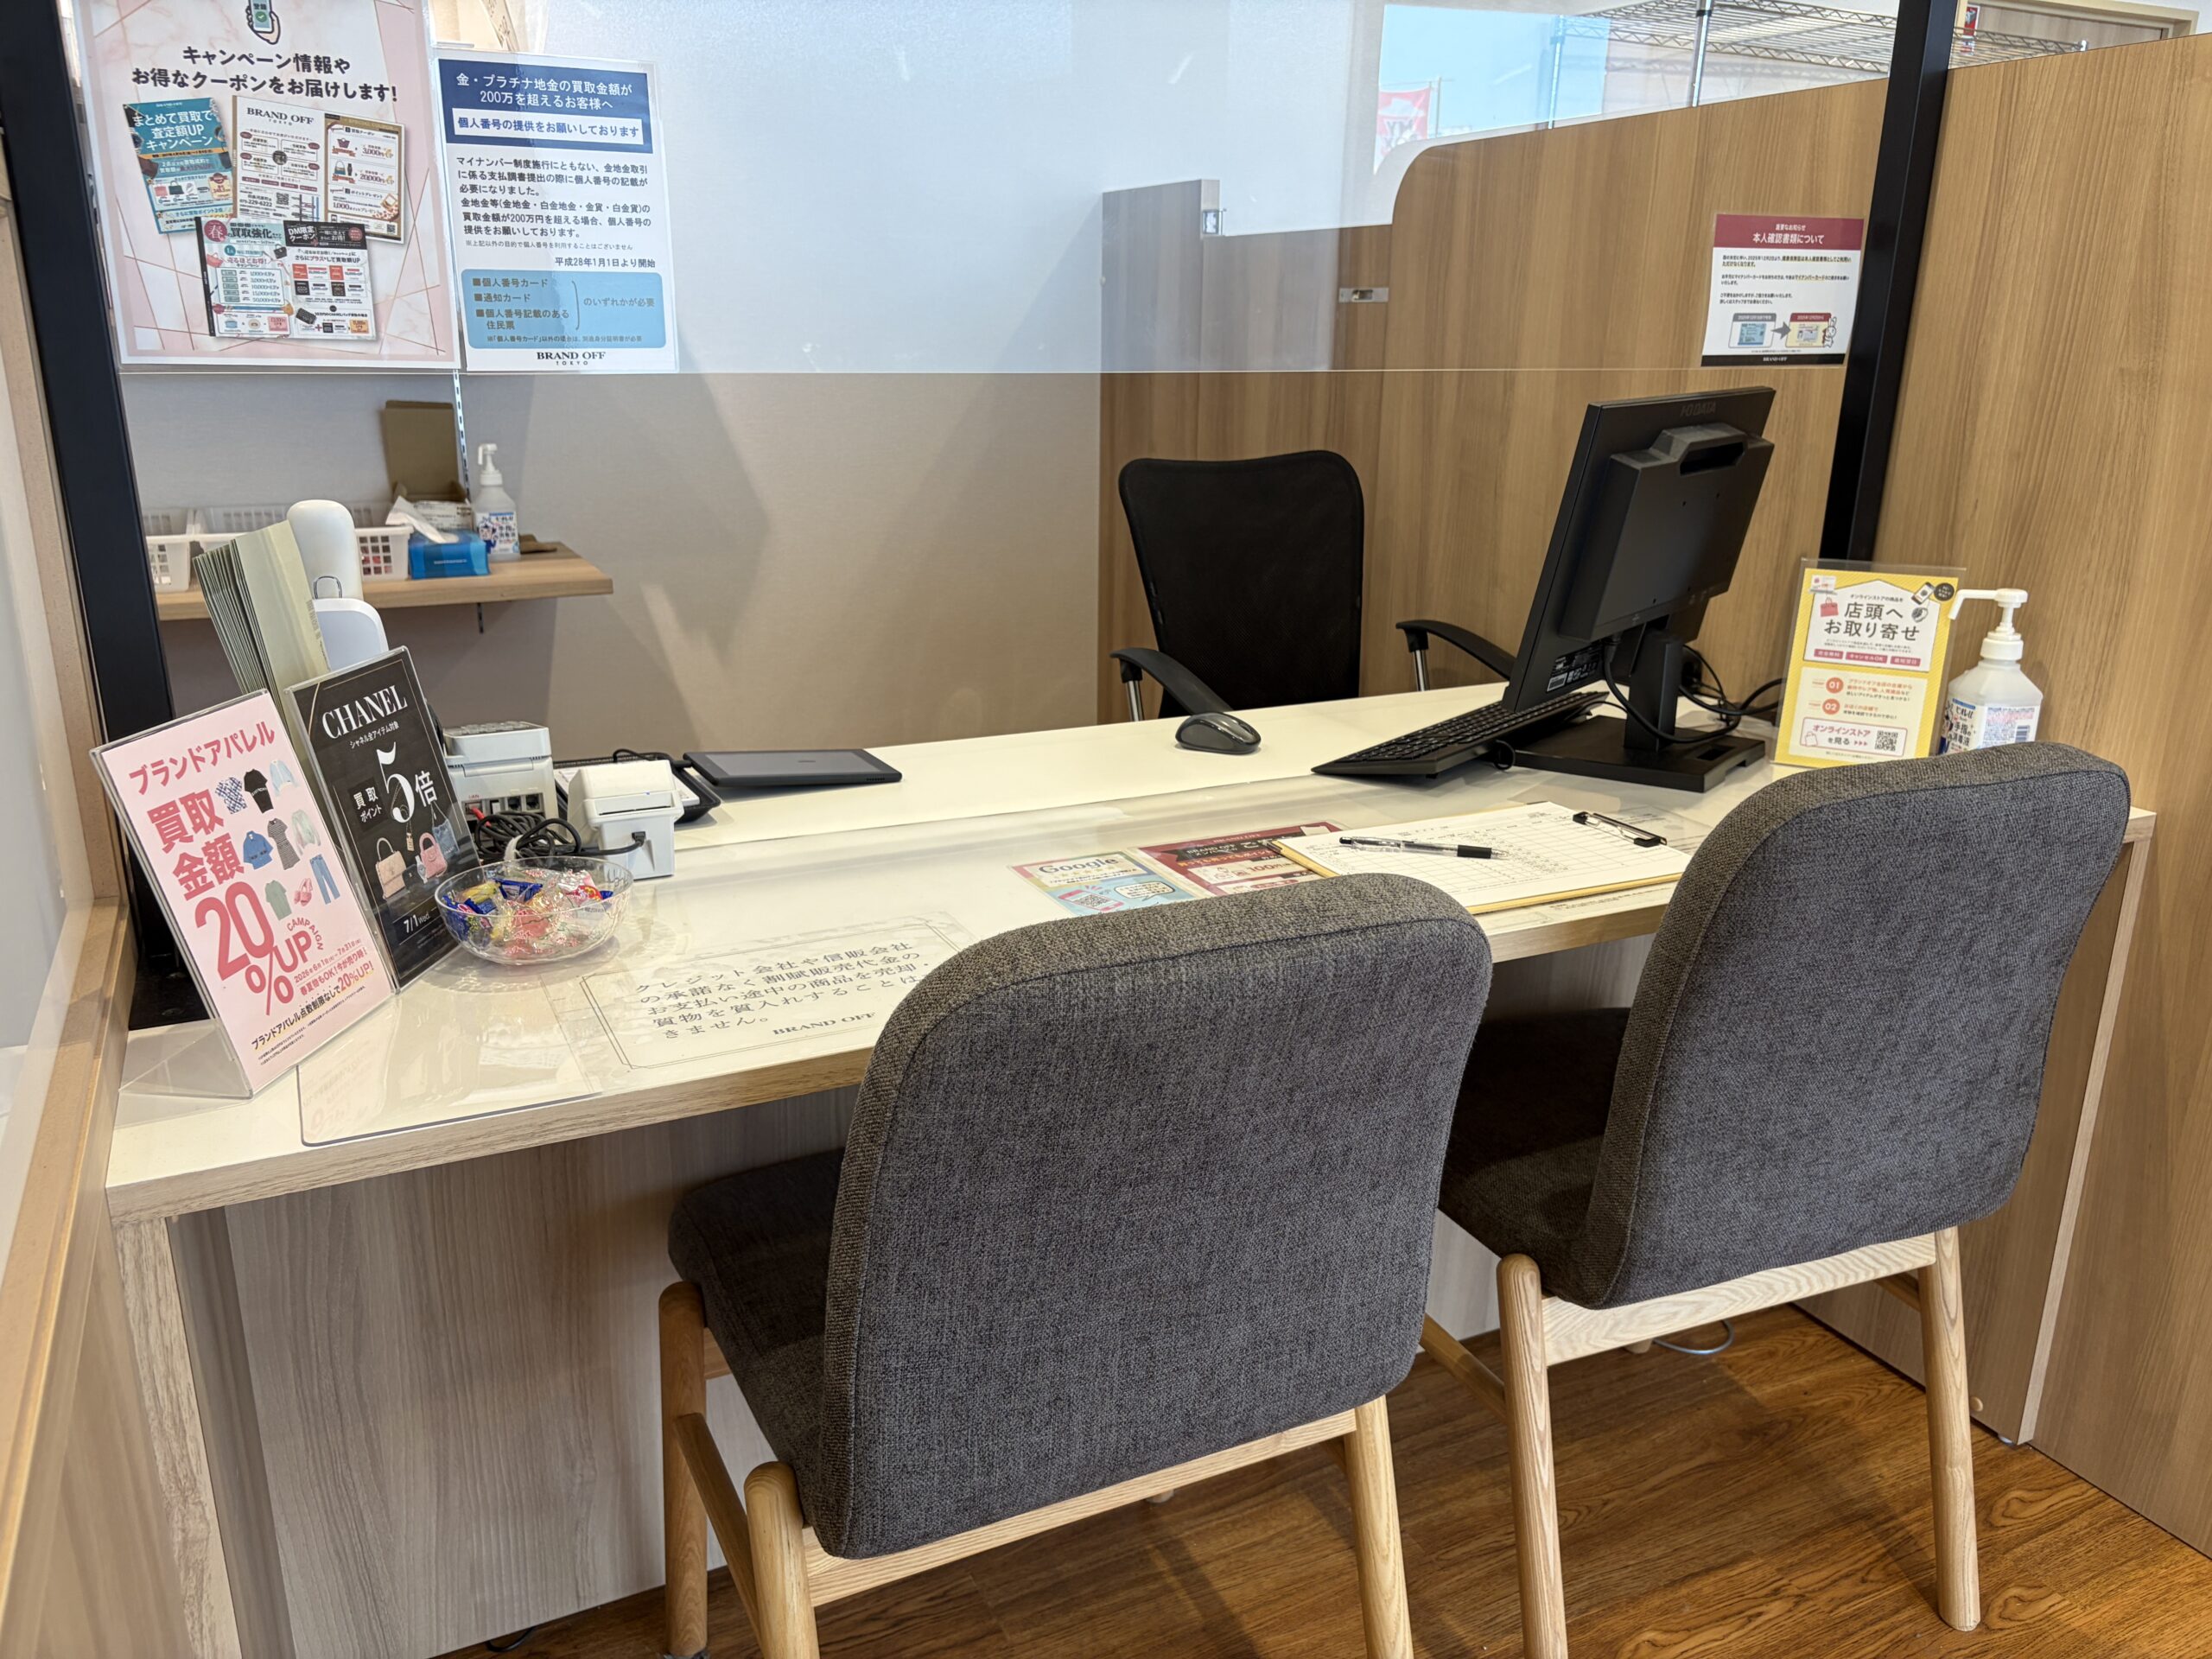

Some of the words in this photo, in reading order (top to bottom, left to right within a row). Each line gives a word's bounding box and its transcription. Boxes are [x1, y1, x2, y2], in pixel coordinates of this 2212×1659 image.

[182, 46, 351, 74] キャンペーン情報や
[131, 67, 398, 102] お得なクーポンをお届けします!
[455, 73, 632, 96] 金・プラチナ地金の買取金額が
[480, 90, 613, 111] 200万を超えるお客様へ
[132, 110, 213, 127] まとめて買取で
[246, 107, 289, 120] BRAND
[290, 114, 315, 125] OFF
[151, 124, 204, 140] 査定額UP
[458, 117, 639, 138] 個人番号の提供をお願いしております
[146, 137, 213, 150] キャンペーン
[456, 156, 648, 175] マイナンバー制度施行にともない、金地金取引
[458, 170, 648, 187] に係る支払調書提出の際に個人番号の記載が
[459, 183, 540, 196] 必要になりました。
[462, 211, 652, 227] 買取金額が200万円を超える場合、個人番号の
[209, 224, 225, 238] 春
[288, 226, 316, 236] DM限定
[289, 233, 316, 242] クーポン
[464, 225, 580, 238] 提供をお願いしております。
[1752, 232, 1825, 245] 本人確認書類について
[555, 256, 656, 269] 平成28年1月1日より開始
[583, 297, 656, 308] のいずれかが必要
[486, 320, 516, 330] 住民票
[537, 352, 579, 360] BRAND
[582, 352, 607, 360] OFF
[1844, 601, 1904, 620] 店頭へ
[1824, 619, 1920, 641] お取り寄せ
[1829, 681, 1840, 690] 01
[321, 685, 408, 739] CHANEL
[1825, 702, 1837, 711] 02
[349, 721, 399, 749] シャネル全アイテム対象
[1813, 724, 1871, 737] オンラインストア
[1827, 737, 1850, 746] を見る
[129, 721, 276, 795] ブランドアパレル
[377, 741, 415, 823] 5
[415, 770, 438, 807] 倍
[353, 786, 378, 810] 買取
[147, 789, 224, 855] 買取
[359, 804, 382, 823] ポイント
[172, 834, 245, 901] 金額
[1039, 857, 1120, 875] Google
[403, 914, 419, 933] 7/1
[286, 917, 324, 951] CAMPAIGN
[636, 941, 914, 994] クレジット会社や信販会社
[639, 952, 921, 1004] の承諾なく割賦販売代金の
[652, 975, 926, 1028] 質物を質入れすることは
[664, 1015, 769, 1039] きません。
[772, 1019, 836, 1035] BRAND
[841, 1011, 878, 1023] OFF
